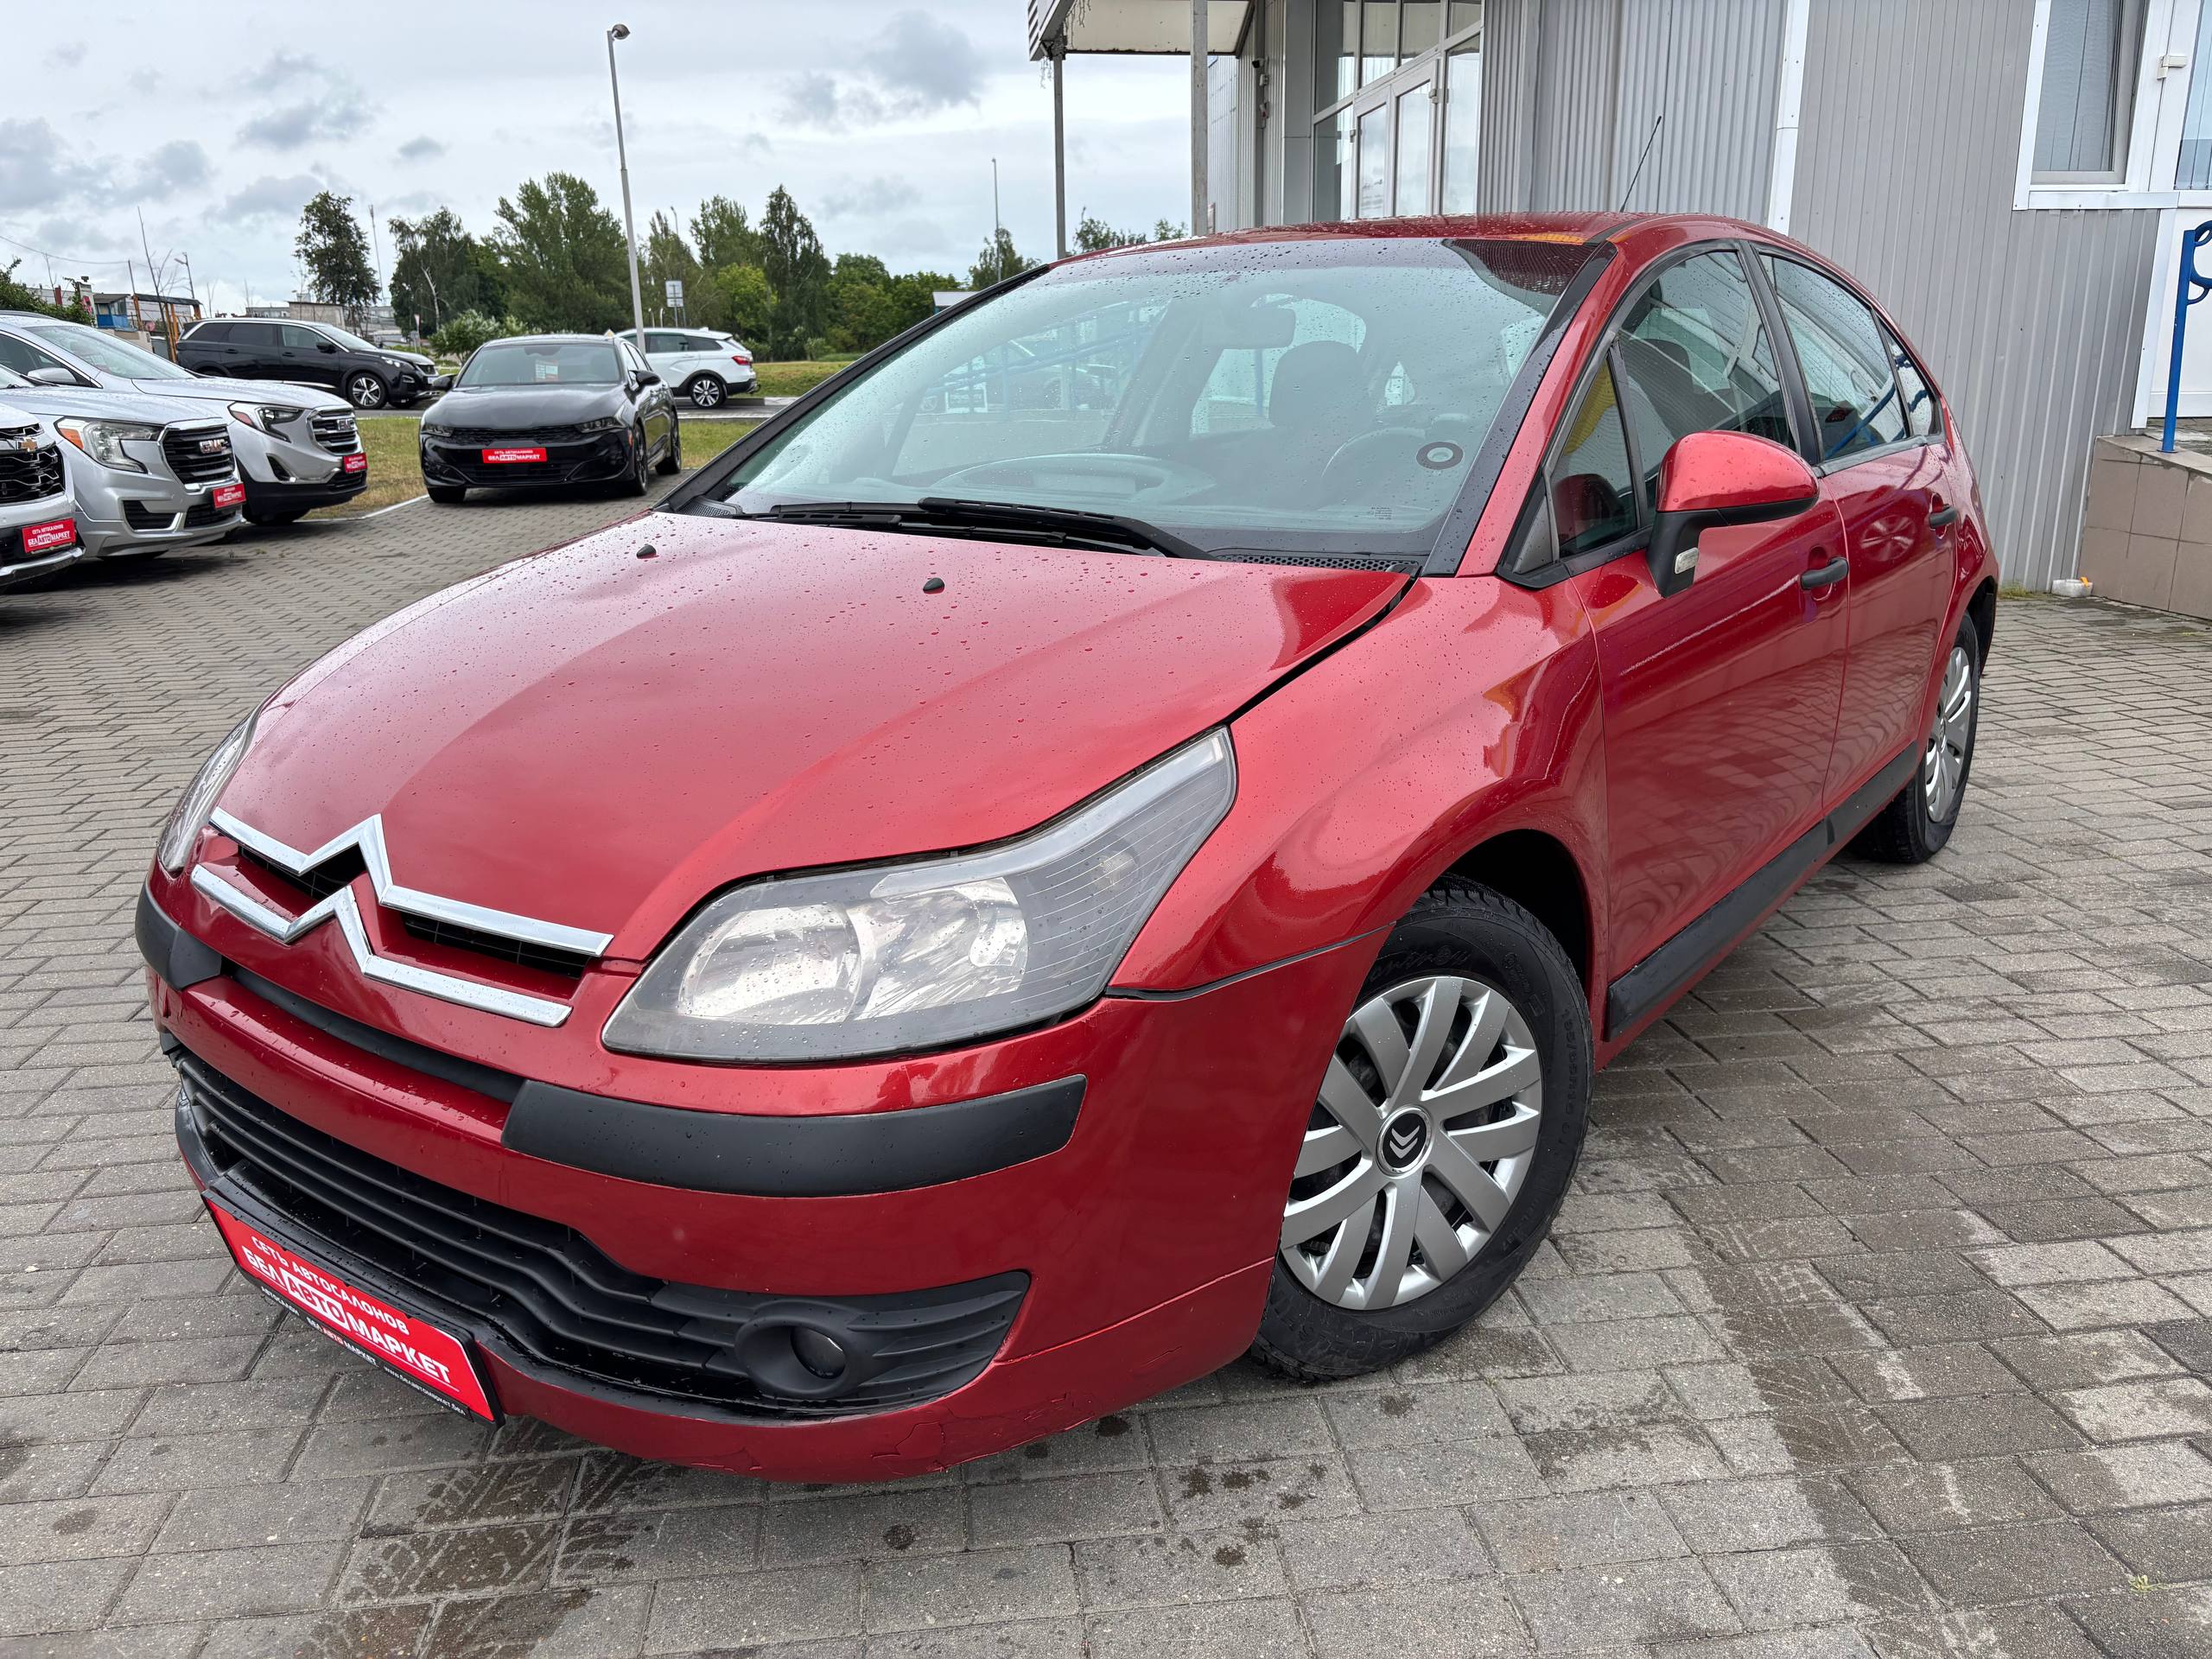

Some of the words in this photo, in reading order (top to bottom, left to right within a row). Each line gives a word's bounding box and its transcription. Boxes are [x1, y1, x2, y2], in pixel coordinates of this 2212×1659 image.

[199, 439, 228, 454] GMC
[251, 1236, 289, 1268] СЕТЬ
[292, 1262, 410, 1336] АВТОСАЛОНОВ
